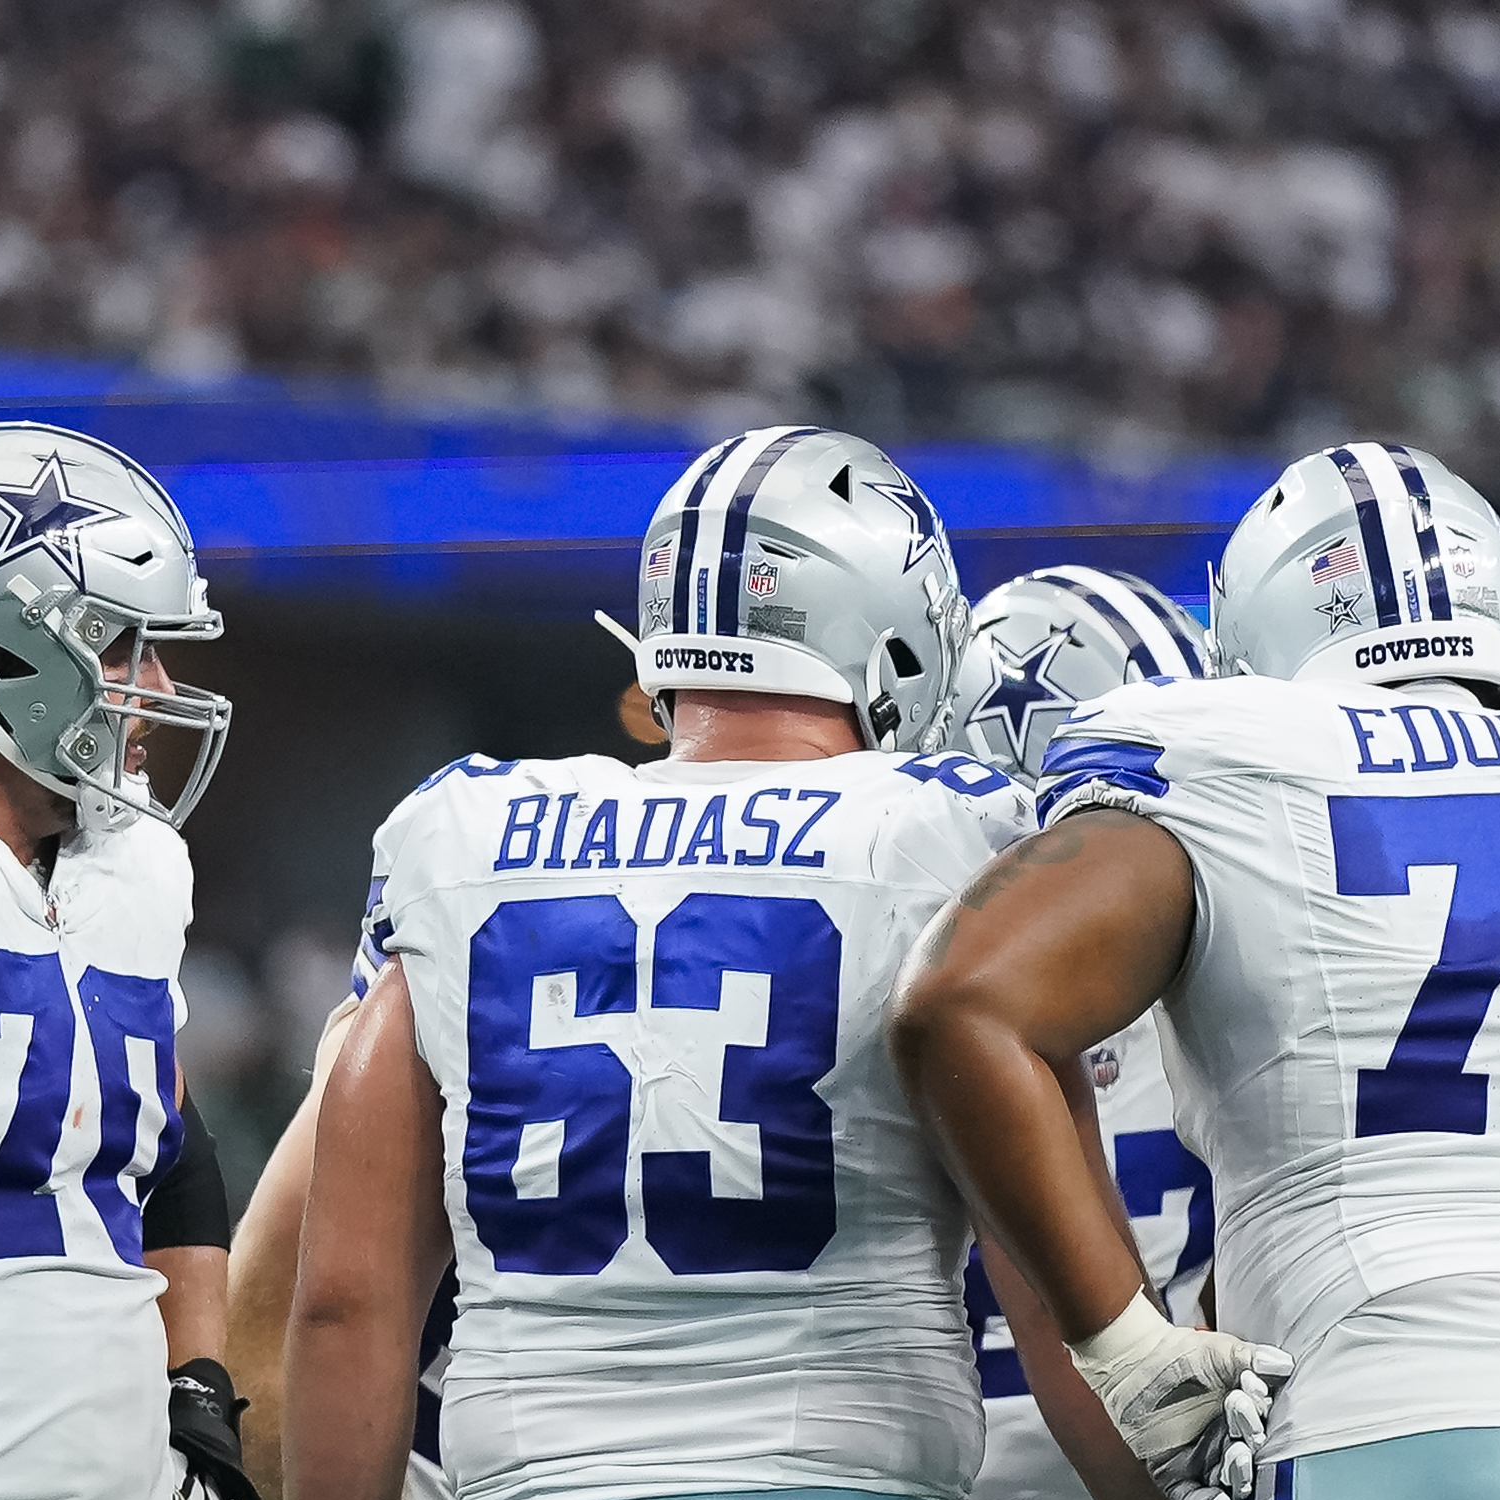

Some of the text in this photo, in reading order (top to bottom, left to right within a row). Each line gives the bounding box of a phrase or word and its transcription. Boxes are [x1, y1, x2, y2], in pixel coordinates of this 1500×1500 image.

[750, 575, 774, 593] NFL
[655, 648, 755, 674] COWBOYS
[1355, 636, 1475, 669] COWBOYS
[493, 788, 841, 871] BIADASZ
[462, 891, 842, 1277] 63
